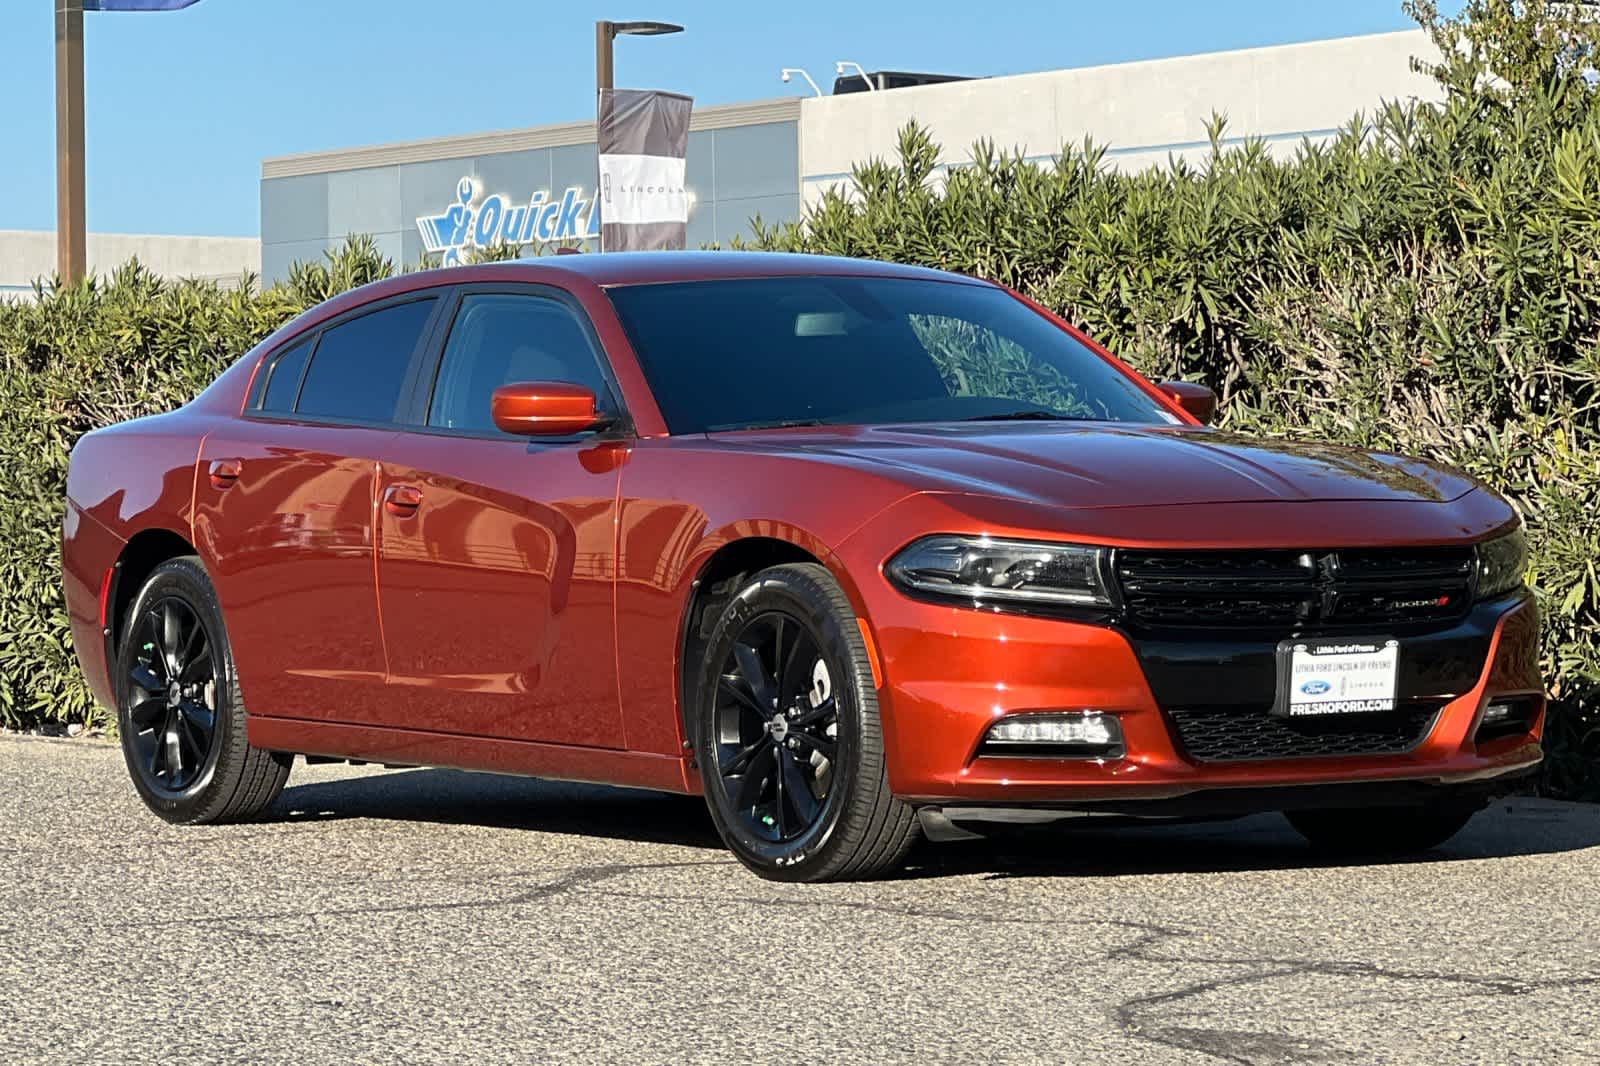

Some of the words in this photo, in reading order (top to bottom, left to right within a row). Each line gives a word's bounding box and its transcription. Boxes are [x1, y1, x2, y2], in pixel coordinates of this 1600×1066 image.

[474, 187, 588, 249] Quick
[1392, 599, 1438, 608] DODGE
[1334, 645, 1348, 654] Ford
[1295, 663, 1314, 673] LITHIA
[1315, 663, 1332, 673] FORD
[1333, 662, 1358, 672] LINCOLN
[1367, 660, 1392, 670] FRESNO
[1290, 700, 1393, 716] FRESNOFORD.COM
